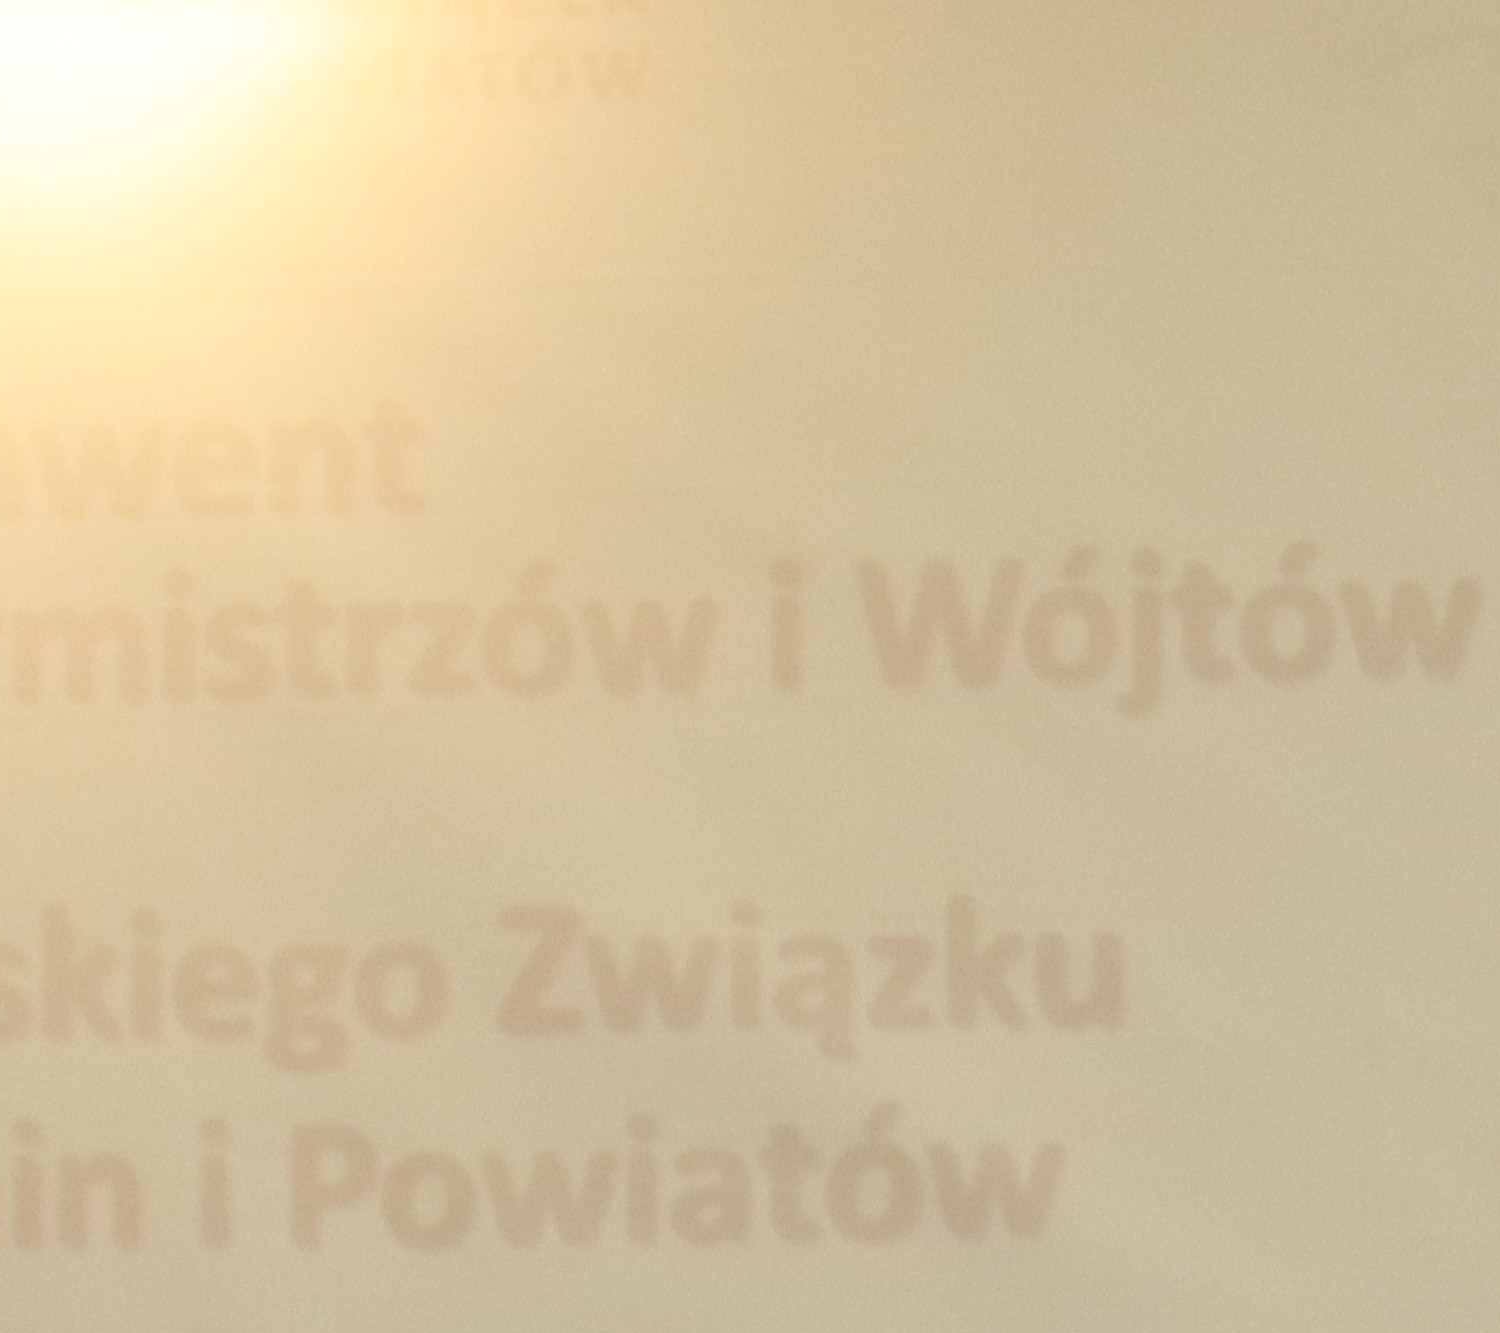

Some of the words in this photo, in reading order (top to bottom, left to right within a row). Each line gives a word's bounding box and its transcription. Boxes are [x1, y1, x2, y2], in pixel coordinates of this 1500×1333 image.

[768, 558, 808, 691] i
[853, 541, 1487, 722] Wójtów
[493, 895, 1129, 1063] Związku
[196, 1117, 233, 1251] i
[286, 1102, 1067, 1253] Powiatów
